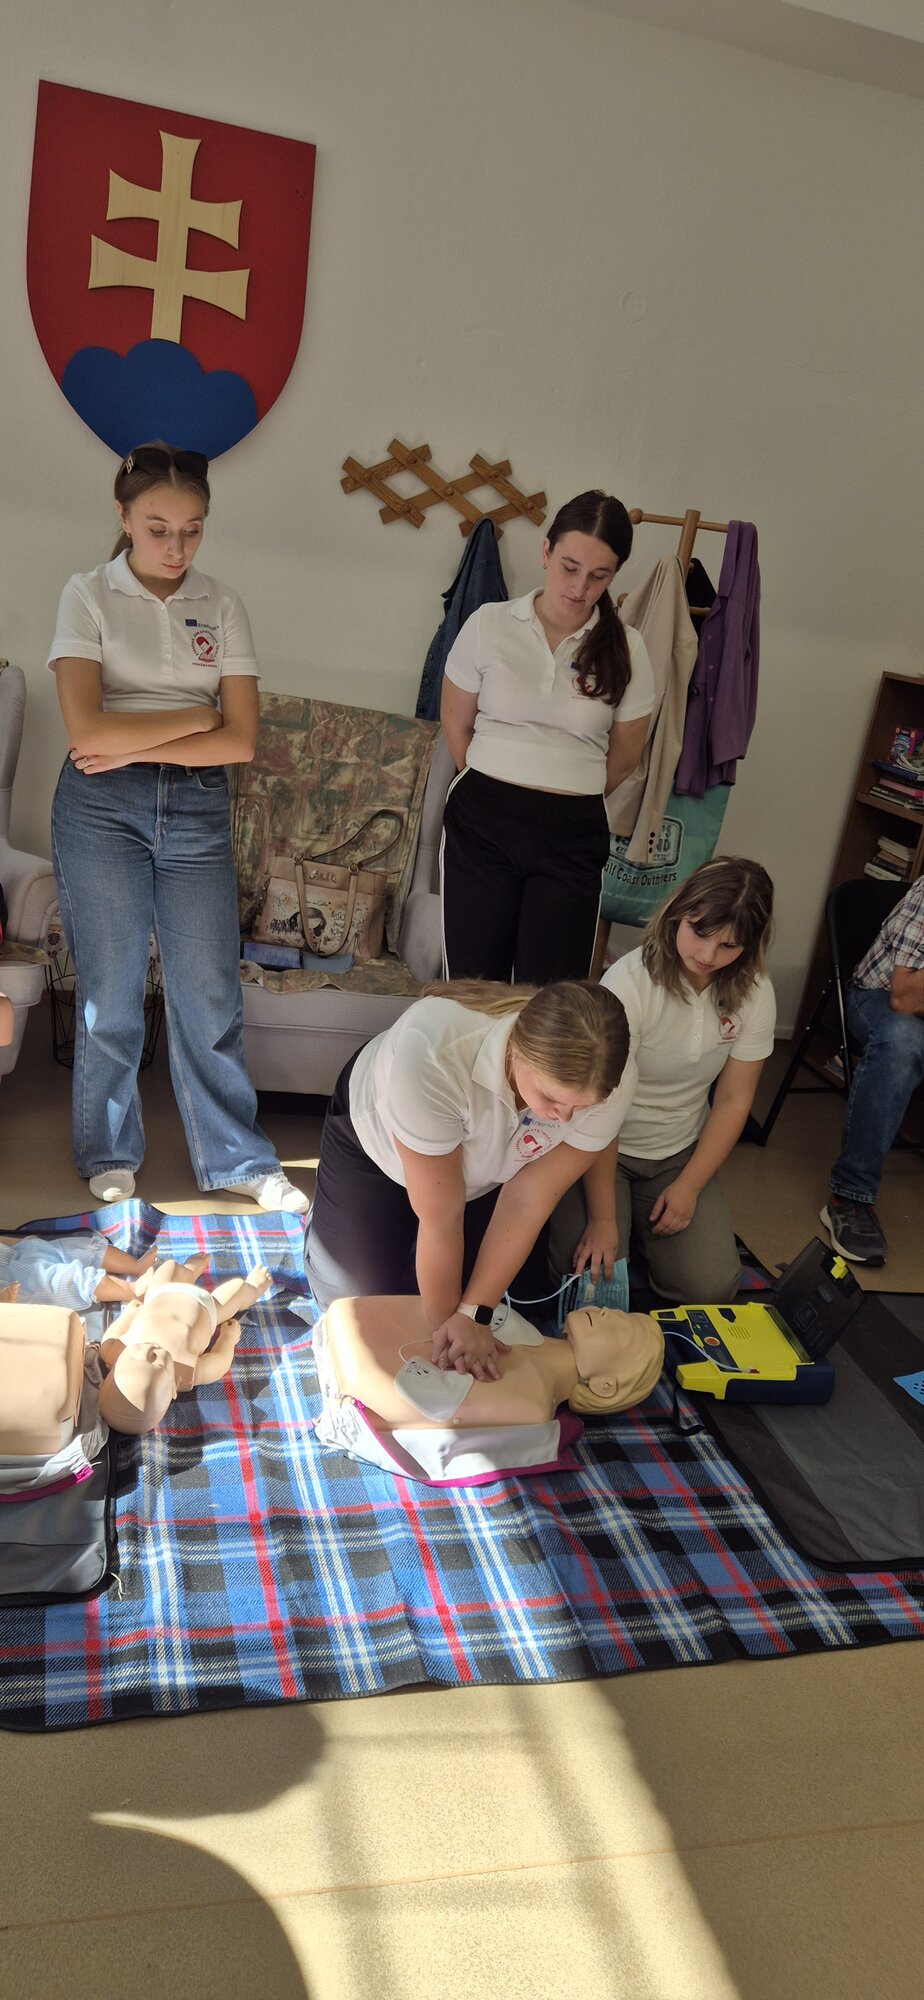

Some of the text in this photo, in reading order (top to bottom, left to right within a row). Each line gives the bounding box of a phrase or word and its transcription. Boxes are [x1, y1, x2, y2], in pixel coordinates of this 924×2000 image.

[604, 862, 677, 886] ulf Coast Outfiters
